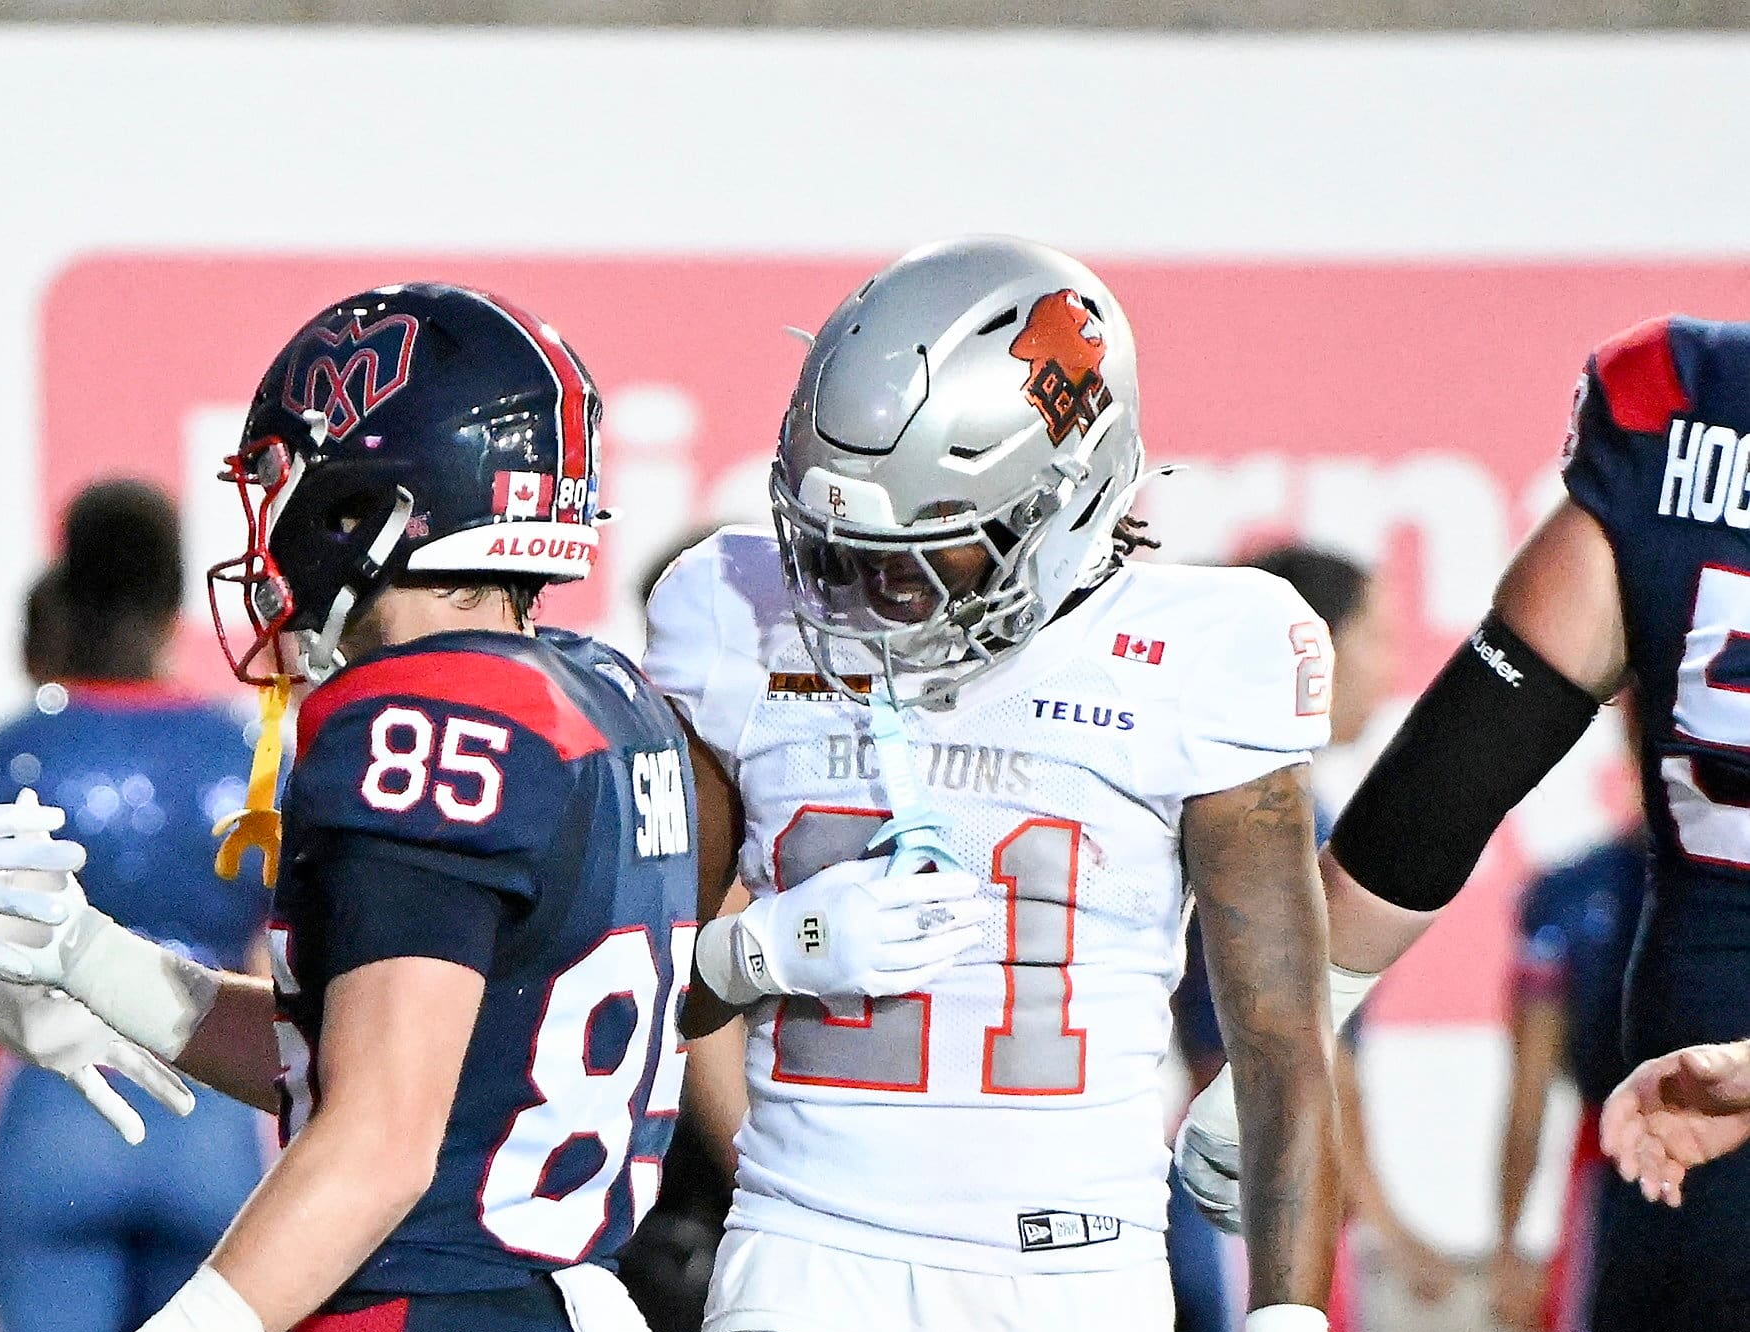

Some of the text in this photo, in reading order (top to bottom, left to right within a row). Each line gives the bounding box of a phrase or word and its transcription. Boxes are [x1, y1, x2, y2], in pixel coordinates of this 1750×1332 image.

[557, 476, 588, 510] 80
[829, 484, 846, 518] BC
[1031, 699, 1135, 731] TELUS
[360, 705, 513, 826] 85
[827, 733, 1034, 797] BC IONS
[771, 803, 1087, 1095] 21
[803, 917, 820, 953] CFL
